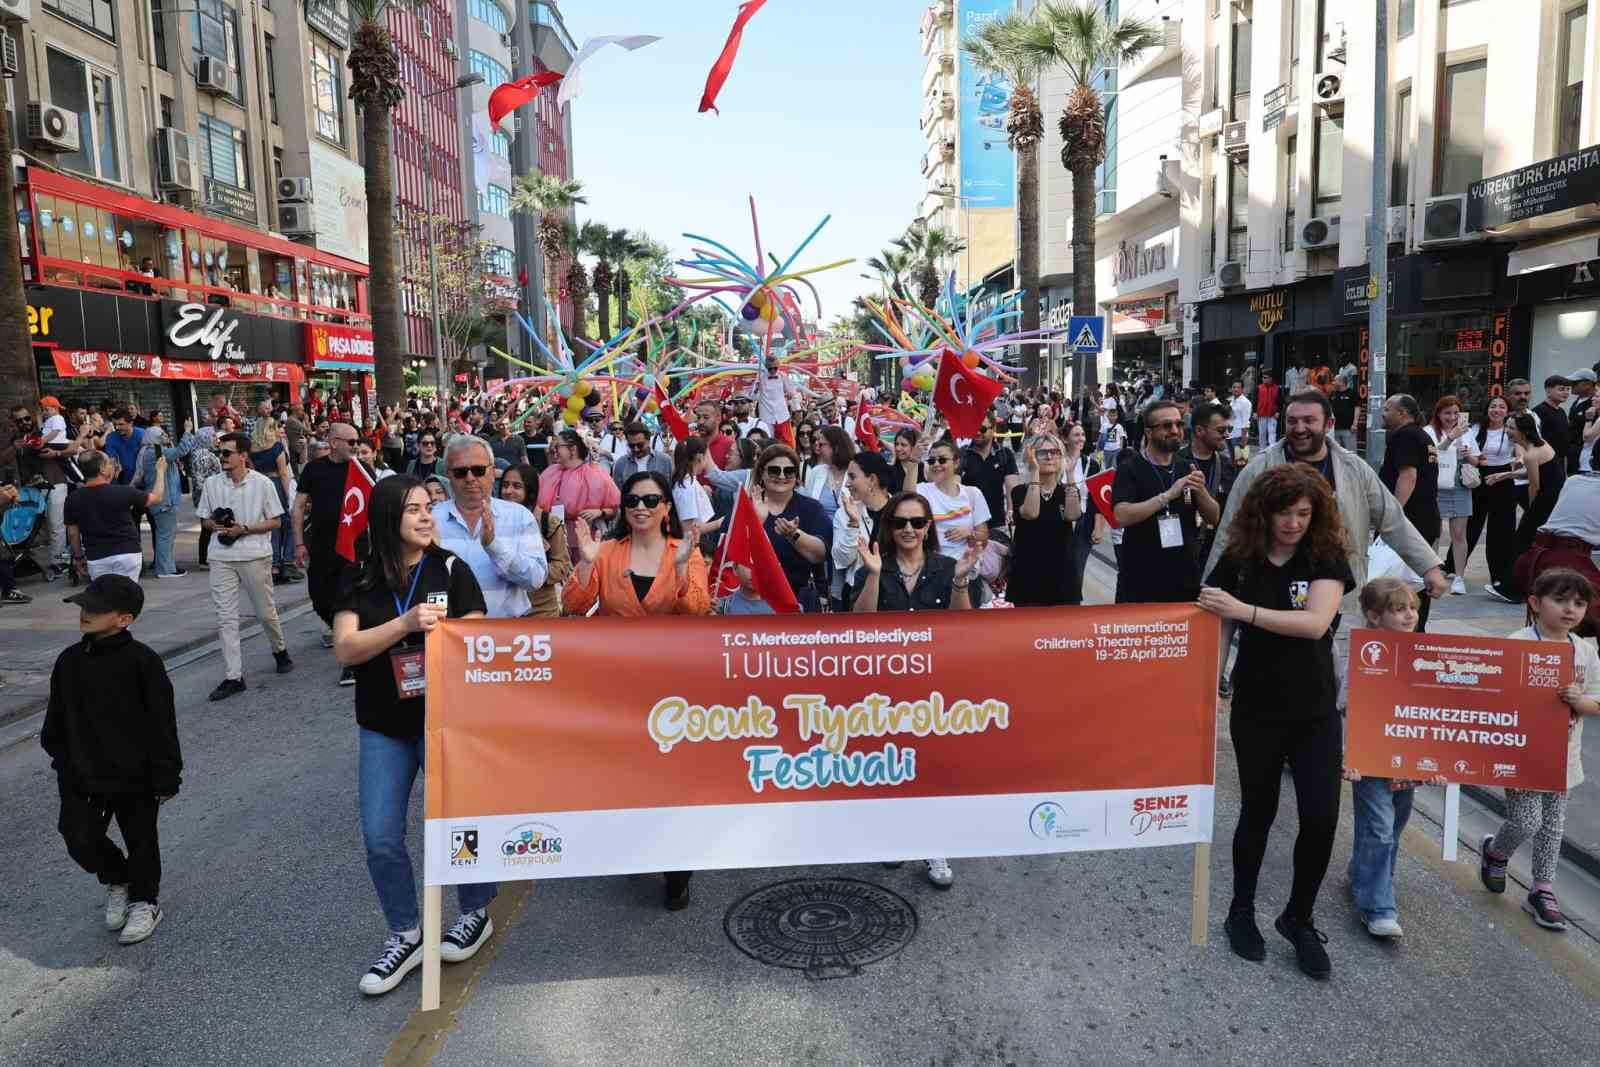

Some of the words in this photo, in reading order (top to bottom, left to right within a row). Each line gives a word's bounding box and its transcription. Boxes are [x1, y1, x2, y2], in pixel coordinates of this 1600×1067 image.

[1471, 165, 1544, 199] YÜREKTÜRK
[1548, 150, 1600, 178] HARİTA
[1250, 290, 1284, 313] MUTLU
[170, 303, 239, 360] Elif
[722, 633, 750, 646] T.C.
[752, 629, 853, 645] Merkezefendi
[856, 627, 932, 646] Belediyesi
[1113, 620, 1189, 634] International
[463, 634, 552, 663] 19-25
[1034, 637, 1094, 650] Children's
[1096, 635, 1142, 647] Theatre
[1144, 633, 1188, 647] Festival
[722, 652, 738, 679] 1.
[744, 650, 933, 679] Uluslararası
[1095, 649, 1128, 660] 19-25
[1130, 647, 1157, 663] April
[1159, 646, 1188, 658] 2025
[1528, 653, 1561, 665] 19-25
[464, 668, 511, 683] Nisan
[514, 667, 552, 681] 2025
[1528, 665, 1560, 676] Nisan
[1528, 675, 1560, 687] 2025
[648, 695, 777, 753] Çocuk
[783, 691, 1010, 753] Tiyatroları
[1395, 704, 1518, 727] MERKEZEFENDİ
[1384, 723, 1427, 740] KENT
[1431, 725, 1527, 747] TİYATROSU
[743, 742, 917, 793] Festivali
[451, 858, 479, 866] KENT
